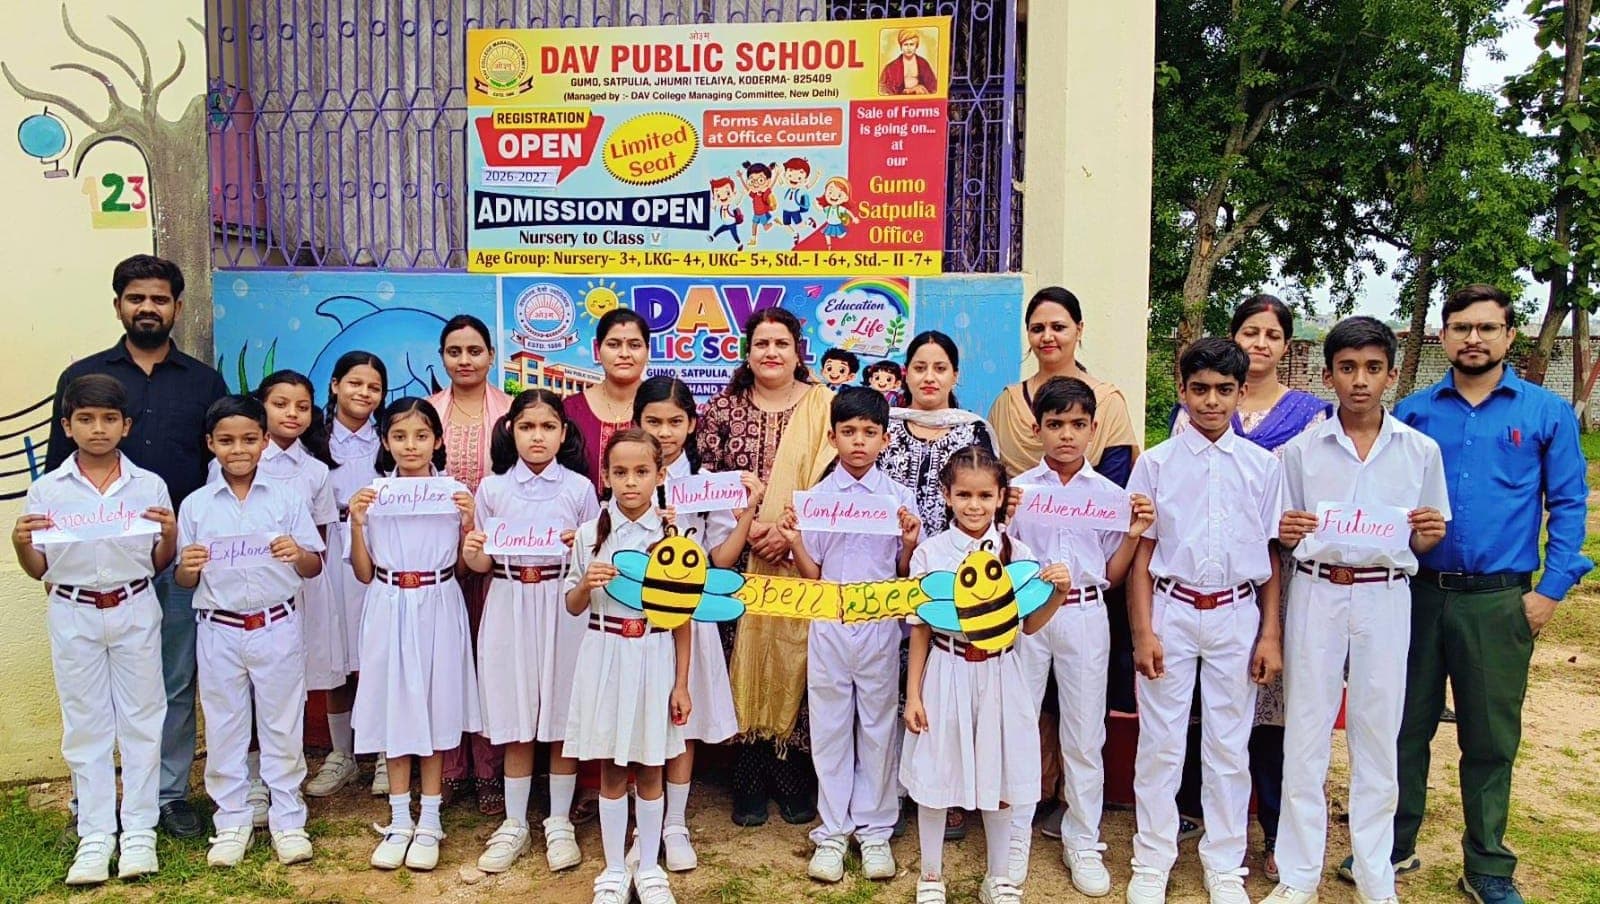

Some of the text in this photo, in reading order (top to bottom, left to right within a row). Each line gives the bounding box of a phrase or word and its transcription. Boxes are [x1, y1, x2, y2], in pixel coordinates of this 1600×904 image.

[540, 39, 864, 74] DAV PUBLIC SCHOOL
[570, 73, 832, 88] GUMO, SATPULIA, JHUMRI TELAIYA, KODERMA- 825409
[563, 92, 607, 102] (Managed
[609, 91, 620, 102] by
[631, 91, 650, 100] DAV
[652, 90, 687, 101] College
[689, 90, 733, 101] Managing
[735, 89, 787, 100] Committee,
[789, 89, 810, 98] New
[812, 88, 839, 99] Delhi)
[497, 112, 585, 125] REGISTRATION
[713, 113, 833, 128] Forms Available
[857, 106, 940, 120] Sale of Forms
[708, 128, 837, 144] at Office Counter
[860, 122, 937, 137] is going on...
[497, 132, 583, 160] OPEN
[609, 125, 688, 160] Limited
[891, 138, 903, 150] at
[628, 151, 678, 178] Seat
[886, 156, 908, 167] our
[484, 170, 548, 184] 2026-2027
[869, 176, 926, 194] Gumo
[477, 196, 704, 225] ADMISSION OPEN
[858, 200, 937, 222] Satpulia
[519, 230, 577, 248] Nursery
[583, 231, 598, 245] to
[602, 230, 645, 246] Class
[869, 226, 925, 245] Office
[475, 251, 501, 268] Age
[504, 251, 550, 268] Group:
[619, 252, 641, 268] 3+,
[683, 252, 705, 268] 4+,
[750, 252, 772, 268] 5+,
[824, 298, 886, 314] Education
[841, 311, 857, 327] for
[851, 316, 885, 338] Life
[681, 367, 731, 379] SATPULIA,
[377, 483, 446, 512] Complex
[671, 480, 744, 508] Nurturing
[45, 501, 137, 531] Knowledge
[803, 498, 888, 522] Confidence
[1026, 493, 1119, 520] Adventure
[1320, 507, 1395, 539] Future
[494, 522, 556, 549] Combat
[209, 541, 271, 567] Explore
[737, 576, 920, 615] Spell Bee
